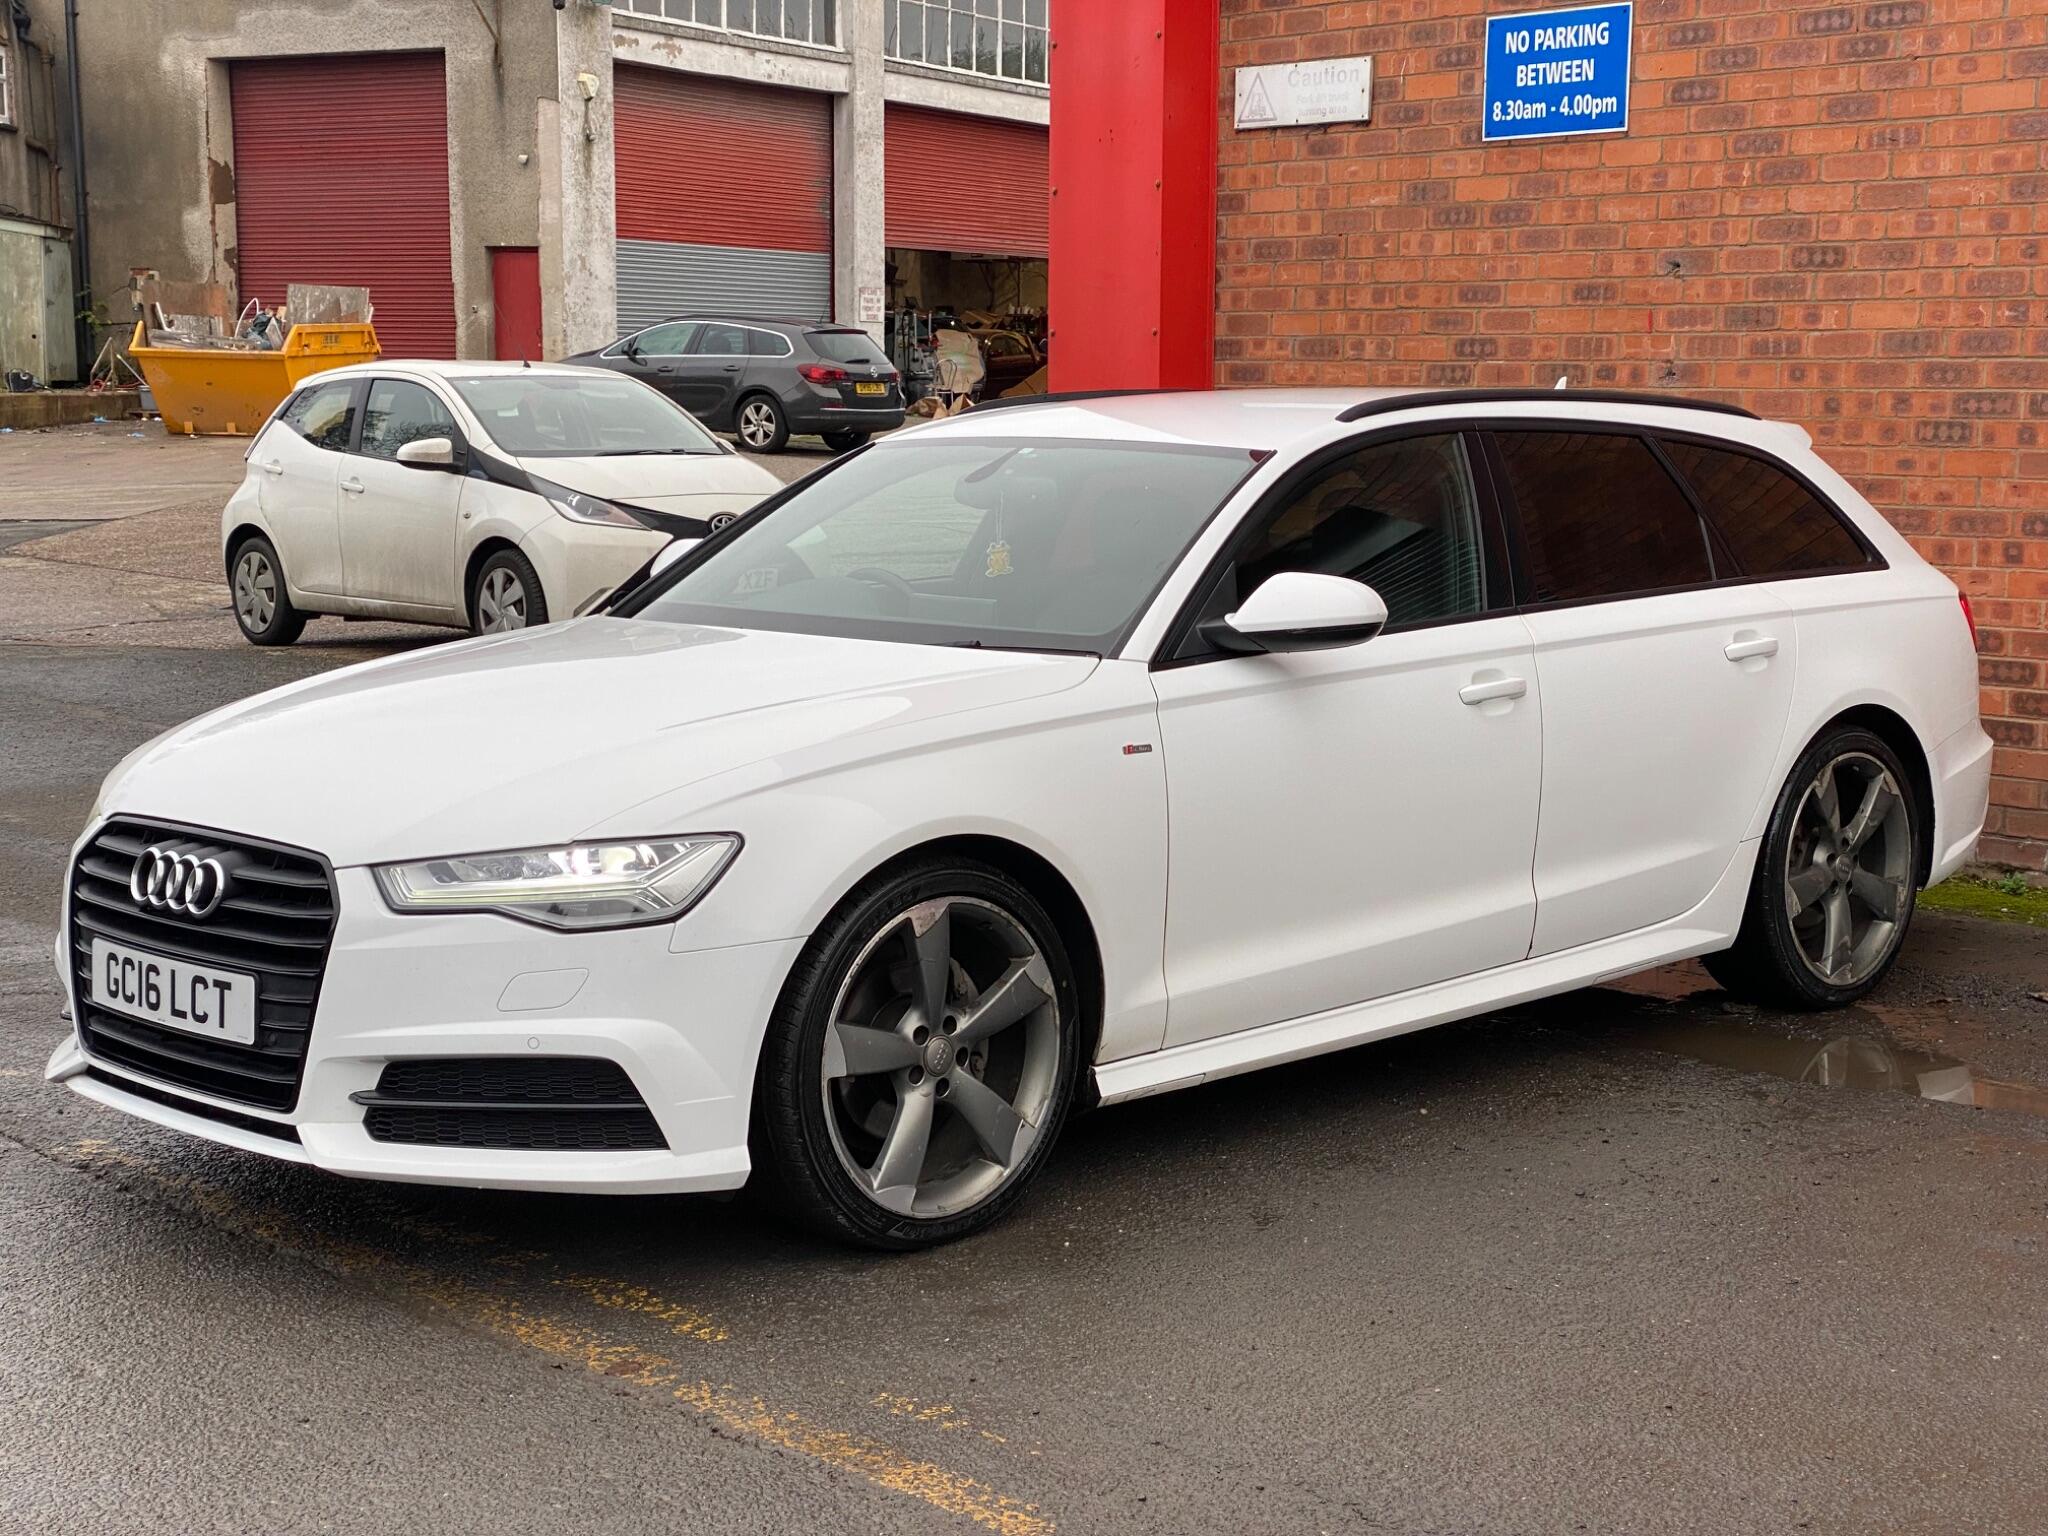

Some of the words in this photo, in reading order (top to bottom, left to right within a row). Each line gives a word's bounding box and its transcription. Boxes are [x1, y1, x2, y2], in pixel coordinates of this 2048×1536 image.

[1505, 30, 1530, 54] NO
[1534, 21, 1610, 52] PARKING
[1288, 66, 1360, 88] Caution
[1516, 58, 1595, 87] BETWEEN
[1492, 99, 1546, 122] 8.30am
[1559, 93, 1617, 119] 4.00pm
[106, 951, 161, 1012] GC16
[170, 968, 232, 1029] LCT
